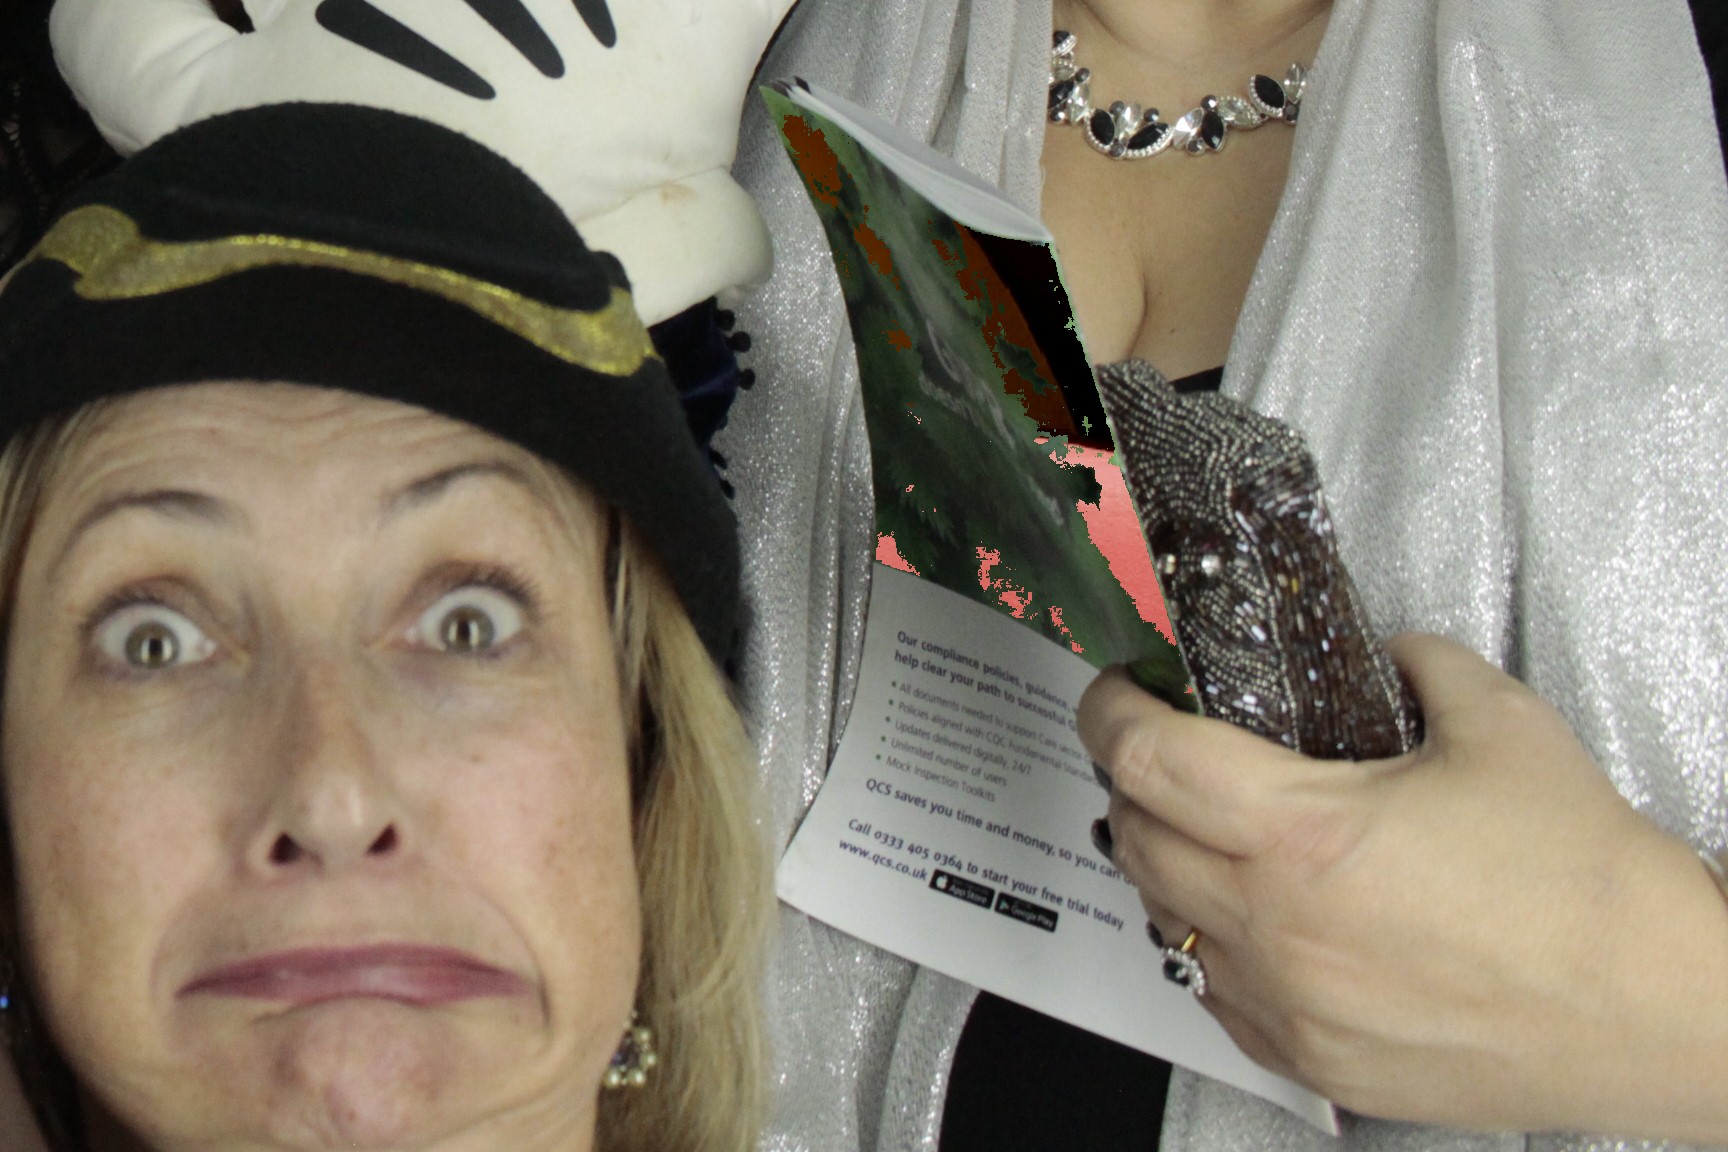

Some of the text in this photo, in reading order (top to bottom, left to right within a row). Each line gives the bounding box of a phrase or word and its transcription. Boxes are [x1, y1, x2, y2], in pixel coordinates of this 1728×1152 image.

[897, 630, 918, 647] Our
[921, 640, 979, 670] compliance
[894, 649, 919, 669] help
[921, 659, 947, 677] clear
[949, 670, 974, 687] your
[977, 681, 1001, 698] path
[1004, 689, 1015, 703] to
[899, 683, 911, 695] All
[912, 688, 959, 711] documents
[894, 719, 930, 741] Updates
[932, 733, 972, 754] delivered
[898, 701, 929, 721] Policies
[931, 713, 962, 732] aligned
[965, 725, 983, 740] with
[886, 755, 996, 802] Mock Inspection Toolkits
[890, 737, 1007, 786] Unlimited number of users
[866, 778, 1121, 880] QCS saves you time and money, so you can
[839, 839, 928, 882] www.qcs.co.uk
[848, 818, 872, 836] Call
[874, 830, 904, 850] 0333
[907, 843, 930, 859] 405
[933, 852, 963, 872] 0364
[967, 862, 978, 874] to
[981, 867, 1008, 885] start
[1011, 878, 1038, 895] your
[1041, 887, 1063, 905] free
[1067, 897, 1090, 916] trial
[1093, 908, 1124, 932] today
